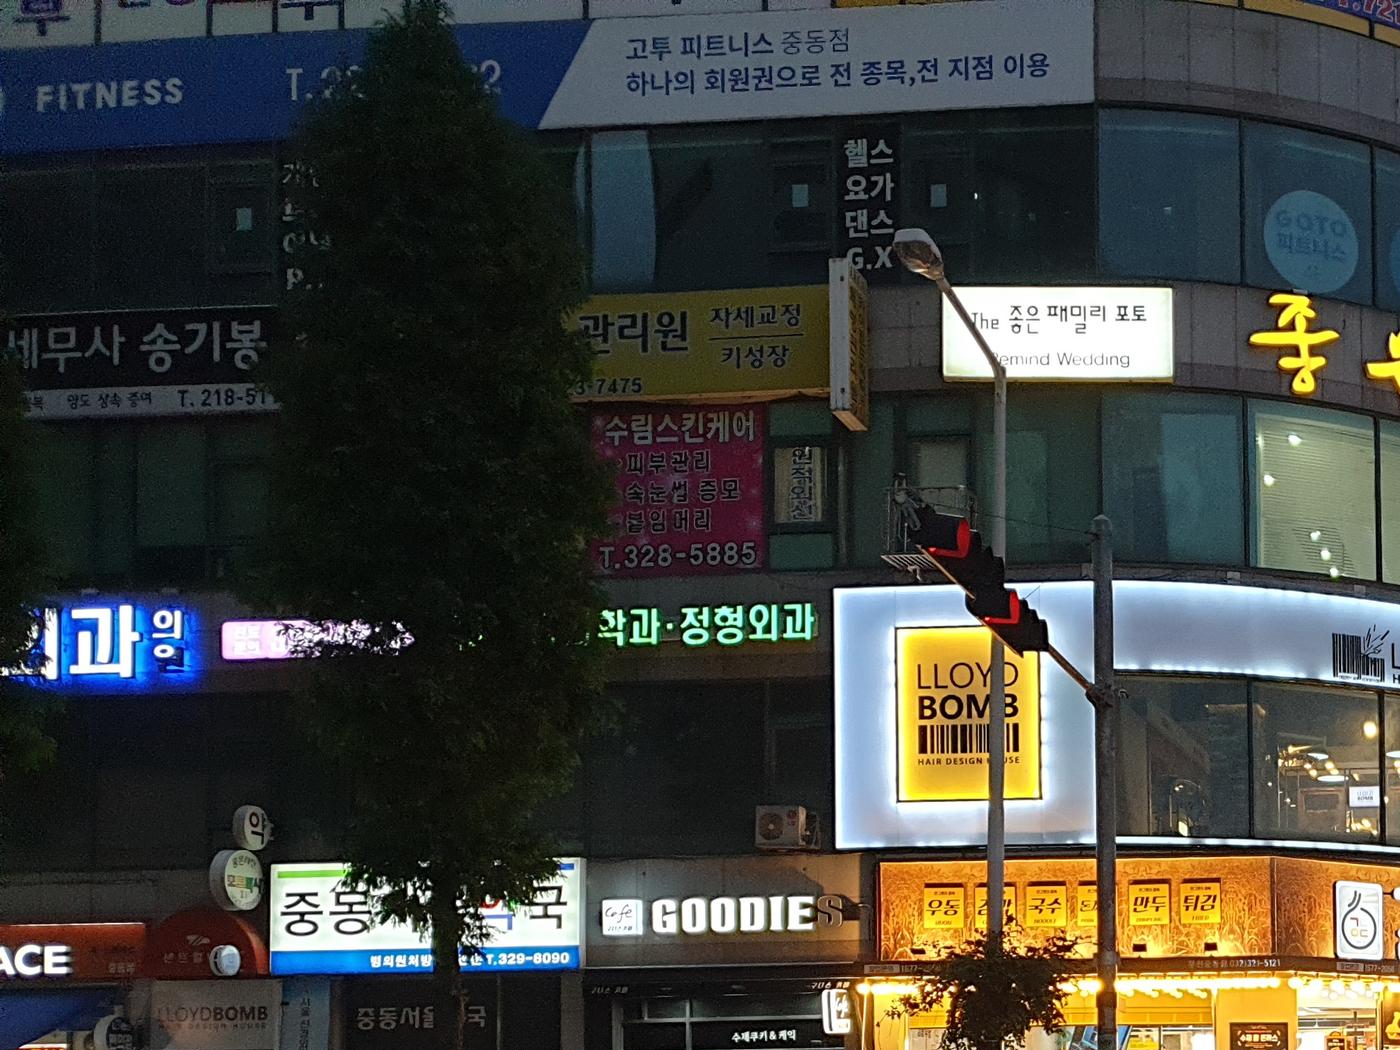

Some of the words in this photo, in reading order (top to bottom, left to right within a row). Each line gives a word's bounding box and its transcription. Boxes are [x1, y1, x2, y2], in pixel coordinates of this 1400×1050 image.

[626, 37, 673, 62] 고투
[680, 31, 775, 60] 피트니스
[781, 27, 851, 56] 중동점
[626, 69, 695, 96] 하나의
[704, 65, 822, 94] 회원권으로
[948, 54, 994, 81] 지점
[1003, 52, 1050, 78] 이용
[36, 77, 185, 113] FITNESS
[843, 138, 895, 168] 헬스
[843, 172, 895, 203] 요가
[844, 209, 894, 239] 댄스
[709, 303, 801, 331] 자세교정
[1008, 305, 1041, 335] 좋은
[1047, 304, 1107, 335] 패밀리
[1115, 304, 1147, 322] 포토
[139, 319, 269, 374] 송기봉
[721, 344, 790, 370] 키성장
[1057, 352, 1131, 368] Wedding
[604, 409, 756, 446] 수림스킨케어
[626, 449, 711, 476] 피부관리
[699, 477, 740, 503] 증모
[599, 541, 756, 569] T.328-5885
[918, 692, 1020, 720] BOMB
[917, 758, 942, 766] HAIR
[946, 757, 983, 766] DESIGN
[925, 898, 961, 917] 우동
[1028, 897, 1063, 915] 국수
[1132, 894, 1168, 913] 만두
[1182, 893, 1218, 912] 튀김
